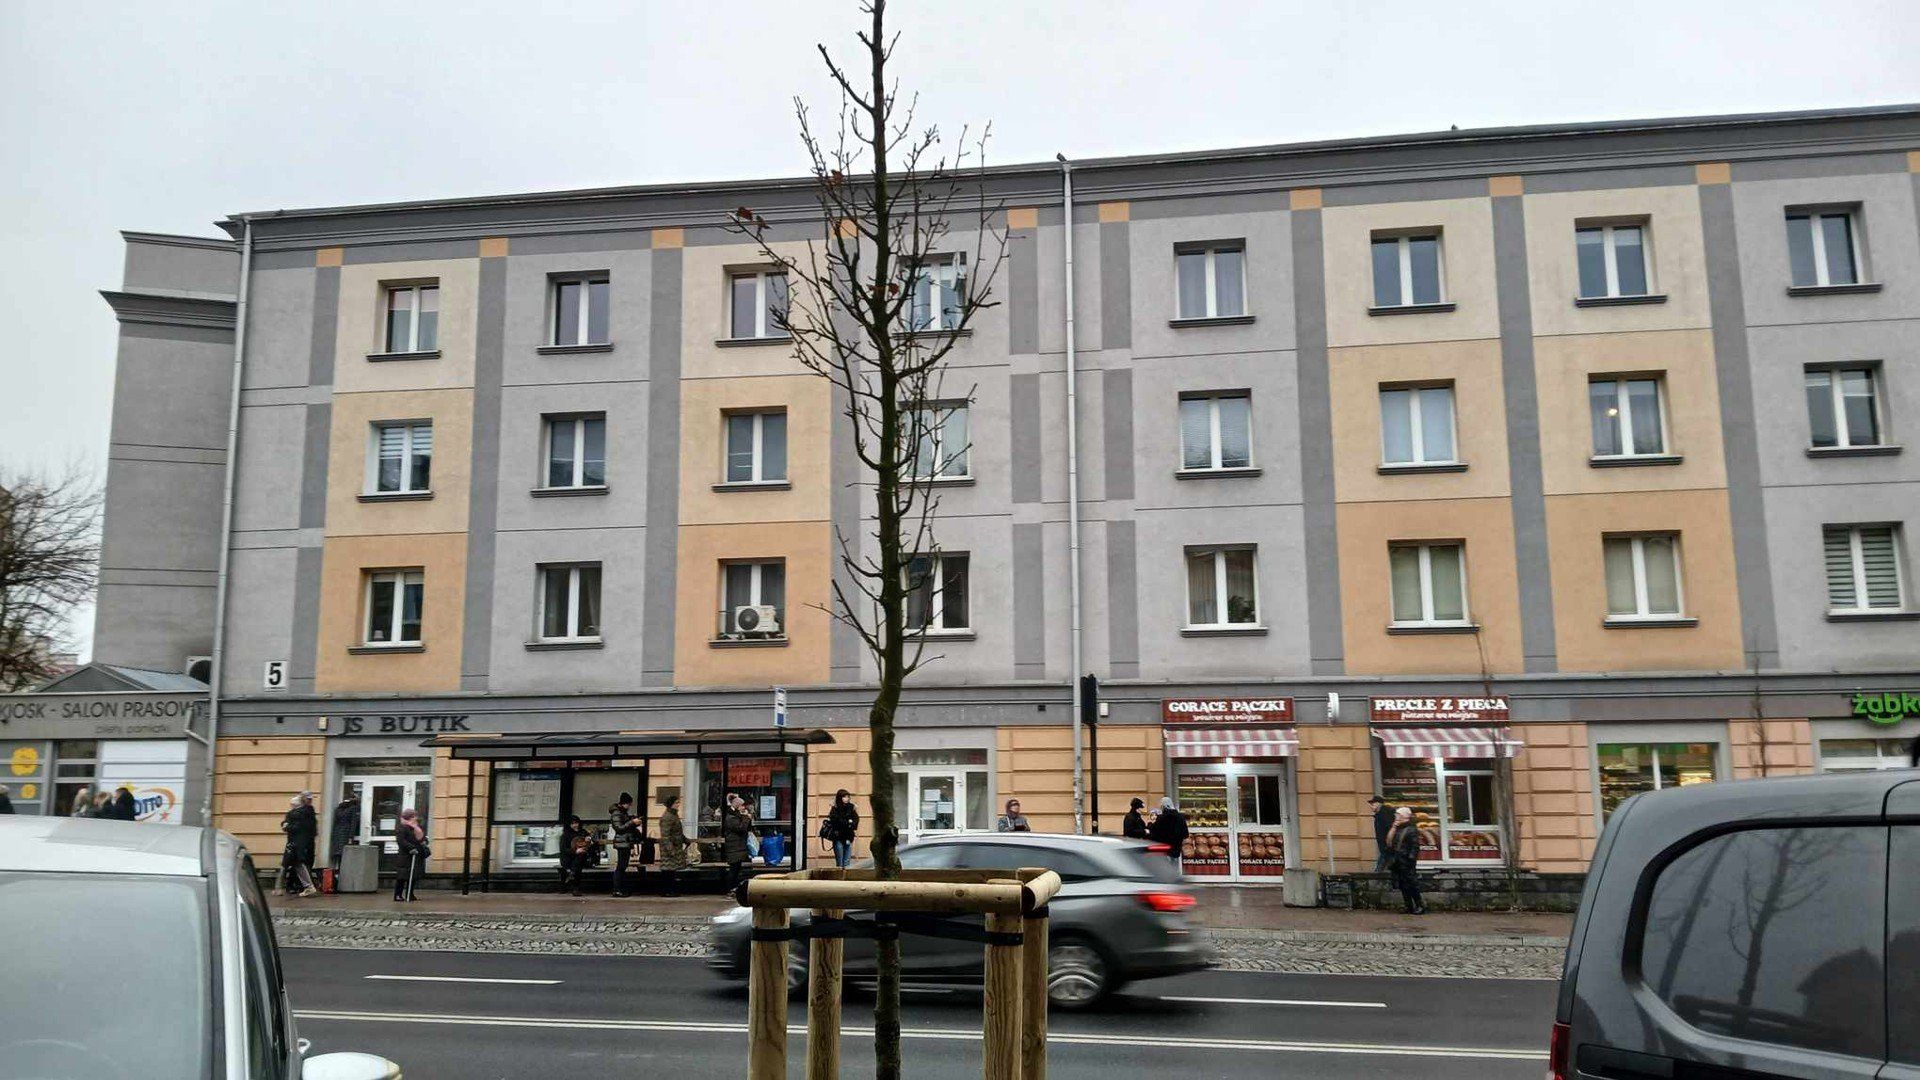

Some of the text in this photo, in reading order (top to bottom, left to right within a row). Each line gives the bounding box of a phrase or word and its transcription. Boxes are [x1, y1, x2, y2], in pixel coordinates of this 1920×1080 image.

[269, 662, 281, 685] 5
[0, 703, 46, 718] KIOSK
[62, 702, 118, 718] SALON
[1168, 700, 1285, 714] GORĄCE PĄCZKI
[1374, 699, 1508, 710] PRECLE Z PIECA
[1852, 691, 1920, 714] żabk
[379, 715, 471, 732] BUTIK
[730, 774, 769, 784] KLEPU
